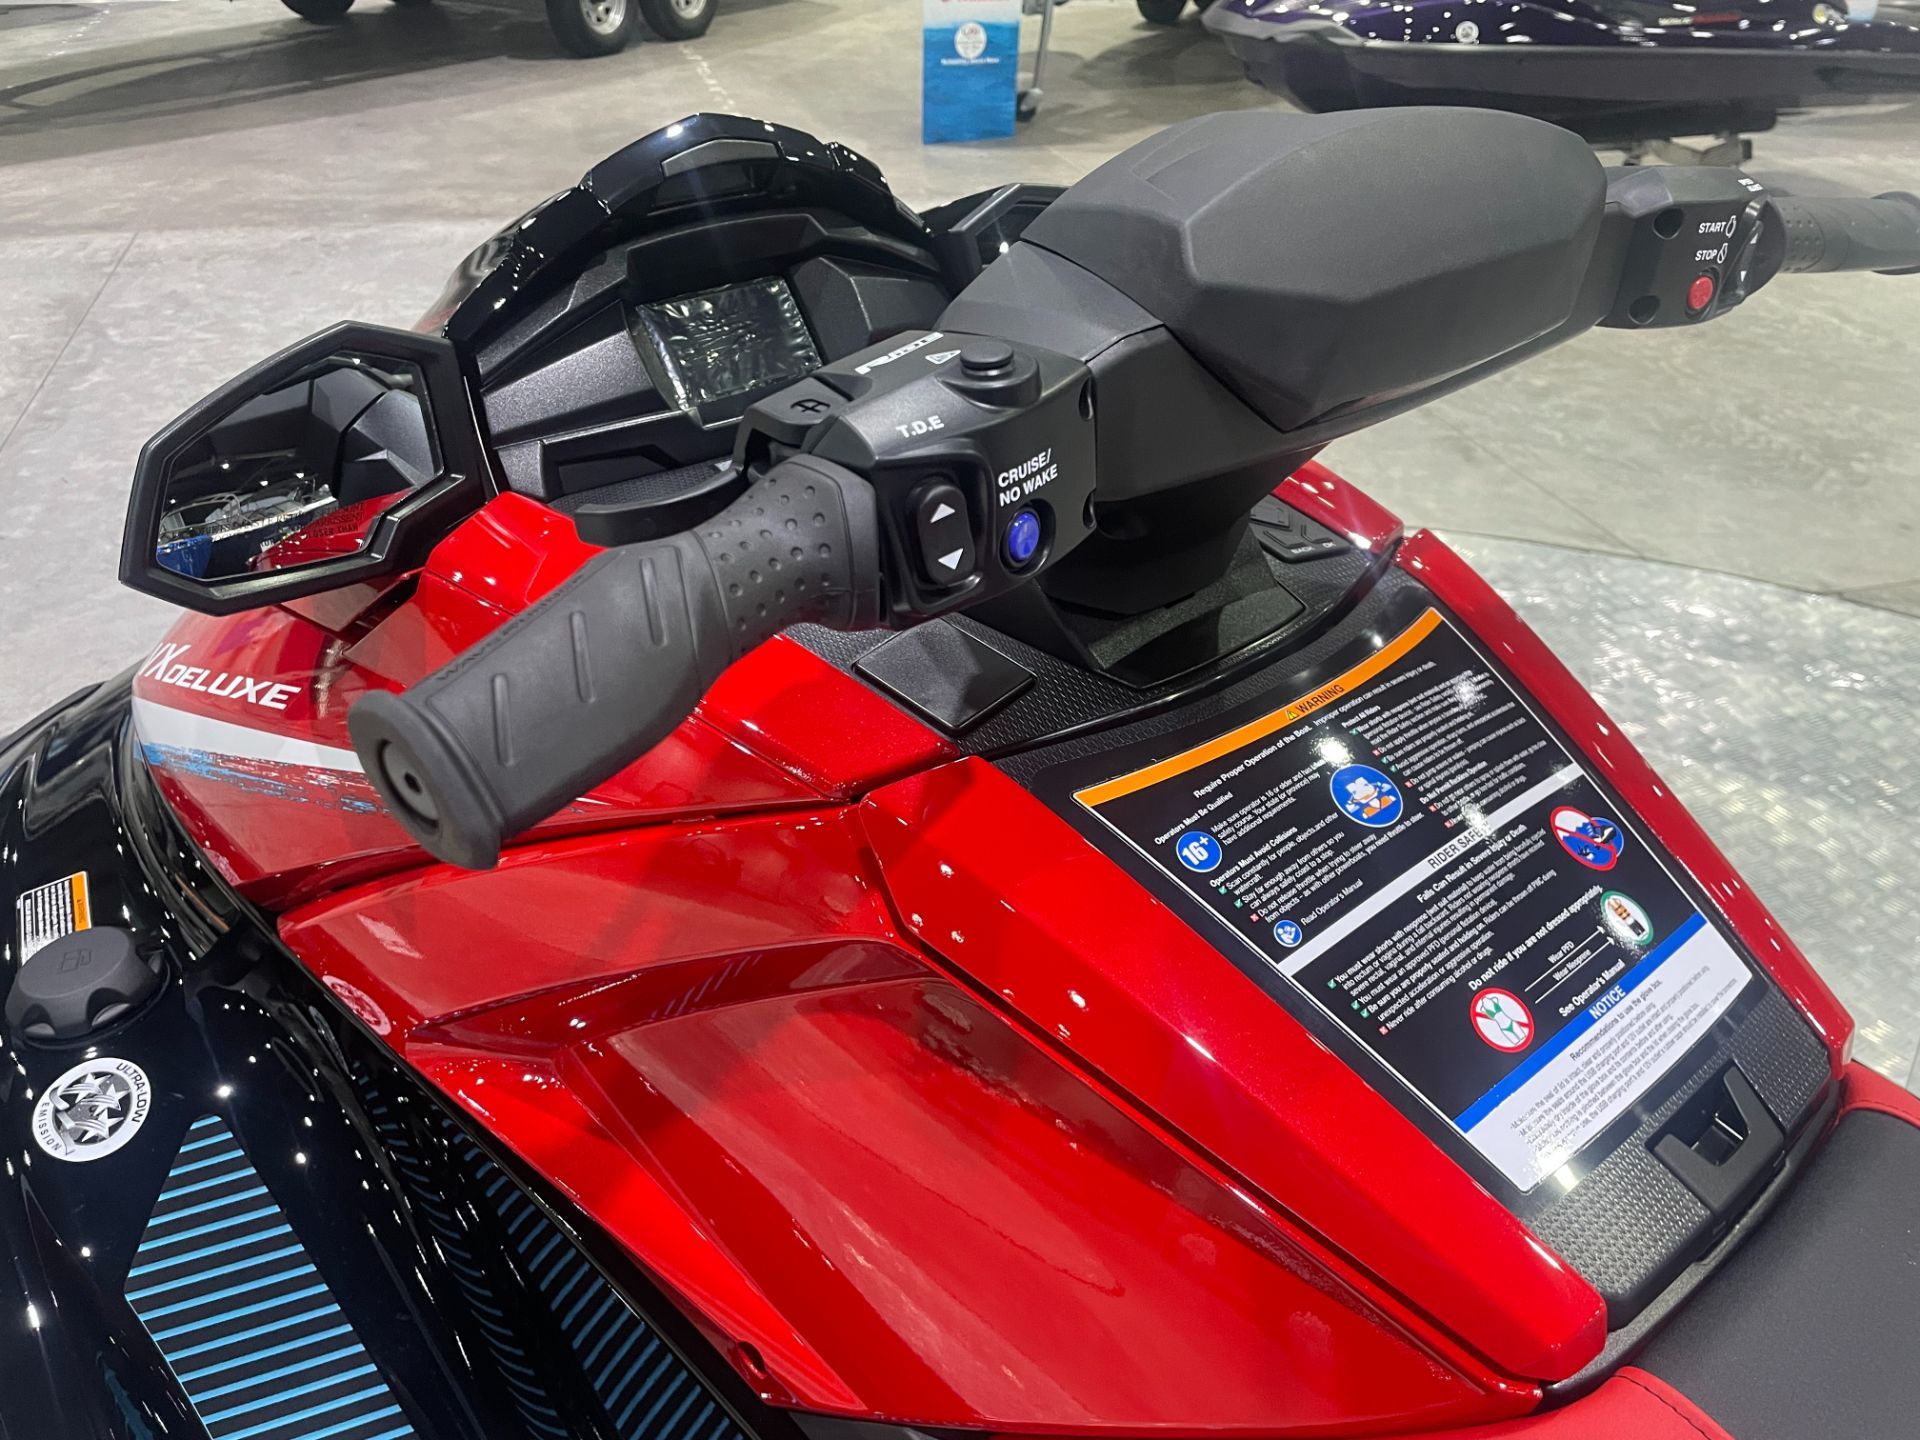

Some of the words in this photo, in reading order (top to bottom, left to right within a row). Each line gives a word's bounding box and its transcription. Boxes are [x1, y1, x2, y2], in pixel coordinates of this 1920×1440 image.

[1698, 221, 1726, 234] START
[1695, 249, 1718, 261] STOP
[896, 415, 945, 438] T.D.E
[998, 448, 1052, 488] CRUISE/
[1000, 487, 1021, 507] NO
[1023, 464, 1058, 497] WAKE
[161, 664, 302, 710] DELUXE
[1295, 684, 1344, 712] WARNING
[1193, 778, 1222, 797] Require
[1220, 764, 1244, 781] Proper
[1243, 745, 1277, 766] Operation
[1293, 725, 1312, 737] Boat.
[1154, 823, 1184, 844] Operators
[1182, 812, 1200, 825] Must
[1206, 791, 1233, 810] Qualified
[1182, 836, 1209, 866] 16+
[1209, 865, 1240, 887] Operators
[1237, 854, 1255, 867] Must
[1253, 842, 1271, 857] Avoid
[1269, 826, 1297, 846] Collisions
[1427, 843, 1459, 868] RIDER
[1457, 818, 1491, 848] SAFE
[1300, 910, 1317, 925] Read
[1315, 893, 1344, 914] Operator's
[1341, 878, 1362, 895] Manual
[1468, 978, 1482, 990] Do
[1480, 967, 1495, 981] not
[1492, 958, 1508, 972] ride
[1511, 943, 1526, 958] you
[1535, 926, 1548, 939] not
[1546, 908, 1570, 930] dressed
[1547, 950, 1563, 963] Wear
[1560, 940, 1574, 953] PFD
[1552, 967, 1568, 980] Wear
[1566, 949, 1593, 971] Neoprene
[1558, 1003, 1574, 1016] See
[1572, 977, 1605, 1005] Operator's
[1601, 958, 1625, 980] Manual
[1589, 985, 1625, 1018] NOTICE
[38, 1102, 62, 1151] EMISSION
